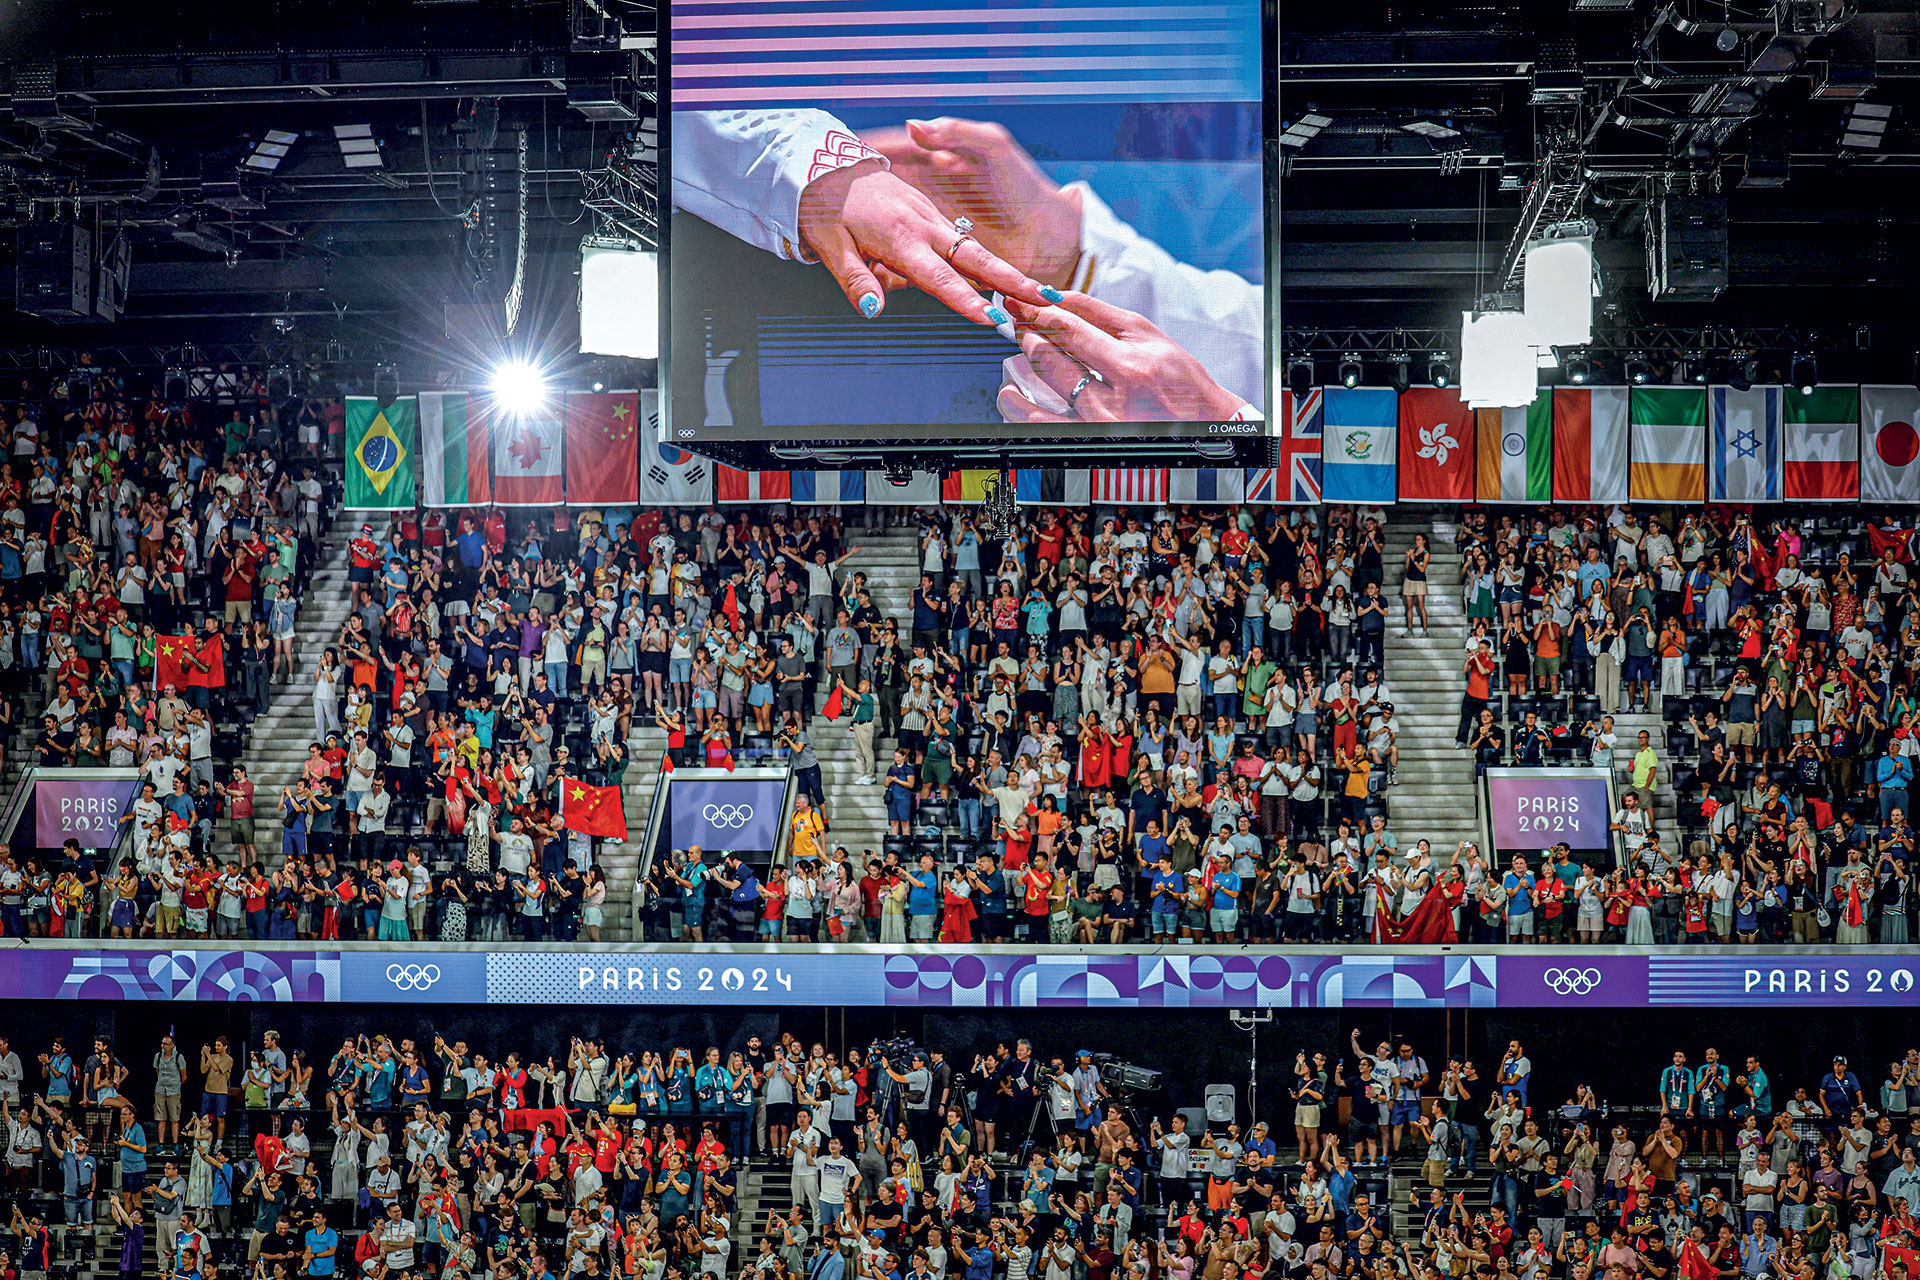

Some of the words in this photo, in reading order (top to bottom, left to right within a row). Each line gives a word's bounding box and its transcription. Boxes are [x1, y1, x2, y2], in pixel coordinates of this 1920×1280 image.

[1220, 424, 1258, 433] OMEGA
[61, 816, 117, 831] 2024
[1518, 815, 1580, 832] 2024
[698, 967, 792, 992] 2024
